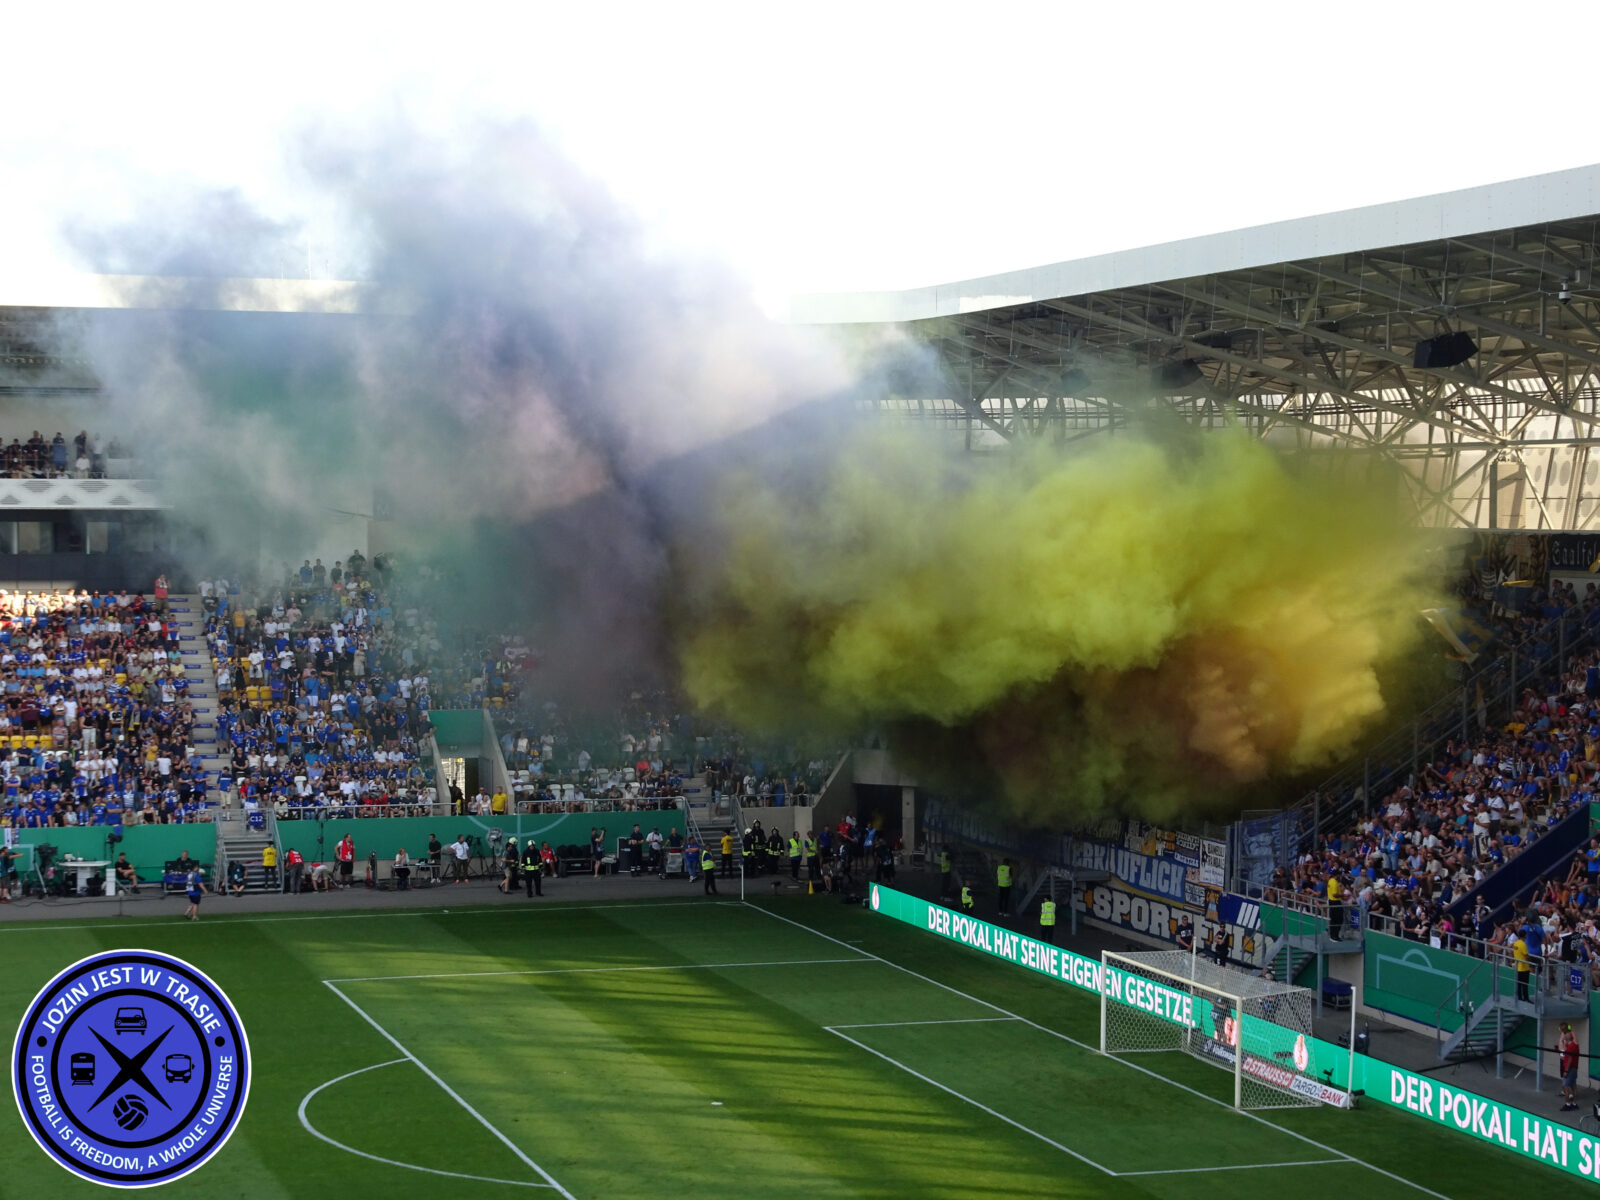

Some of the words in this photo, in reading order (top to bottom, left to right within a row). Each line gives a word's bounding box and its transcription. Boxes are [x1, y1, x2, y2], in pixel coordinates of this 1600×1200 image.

[250, 815, 263, 823] C12
[928, 905, 950, 936] DER
[952, 914, 992, 952] POKAL
[994, 929, 1019, 961] HAT
[1021, 938, 1058, 976] SEINE
[1061, 952, 1122, 999] EIGENEN
[1125, 976, 1196, 1027] GESETZE.
[1570, 974, 1582, 985] C17
[1391, 1069, 1433, 1116] DER
[1439, 1086, 1517, 1148] POKAL
[1523, 1116, 1573, 1167] HAT
